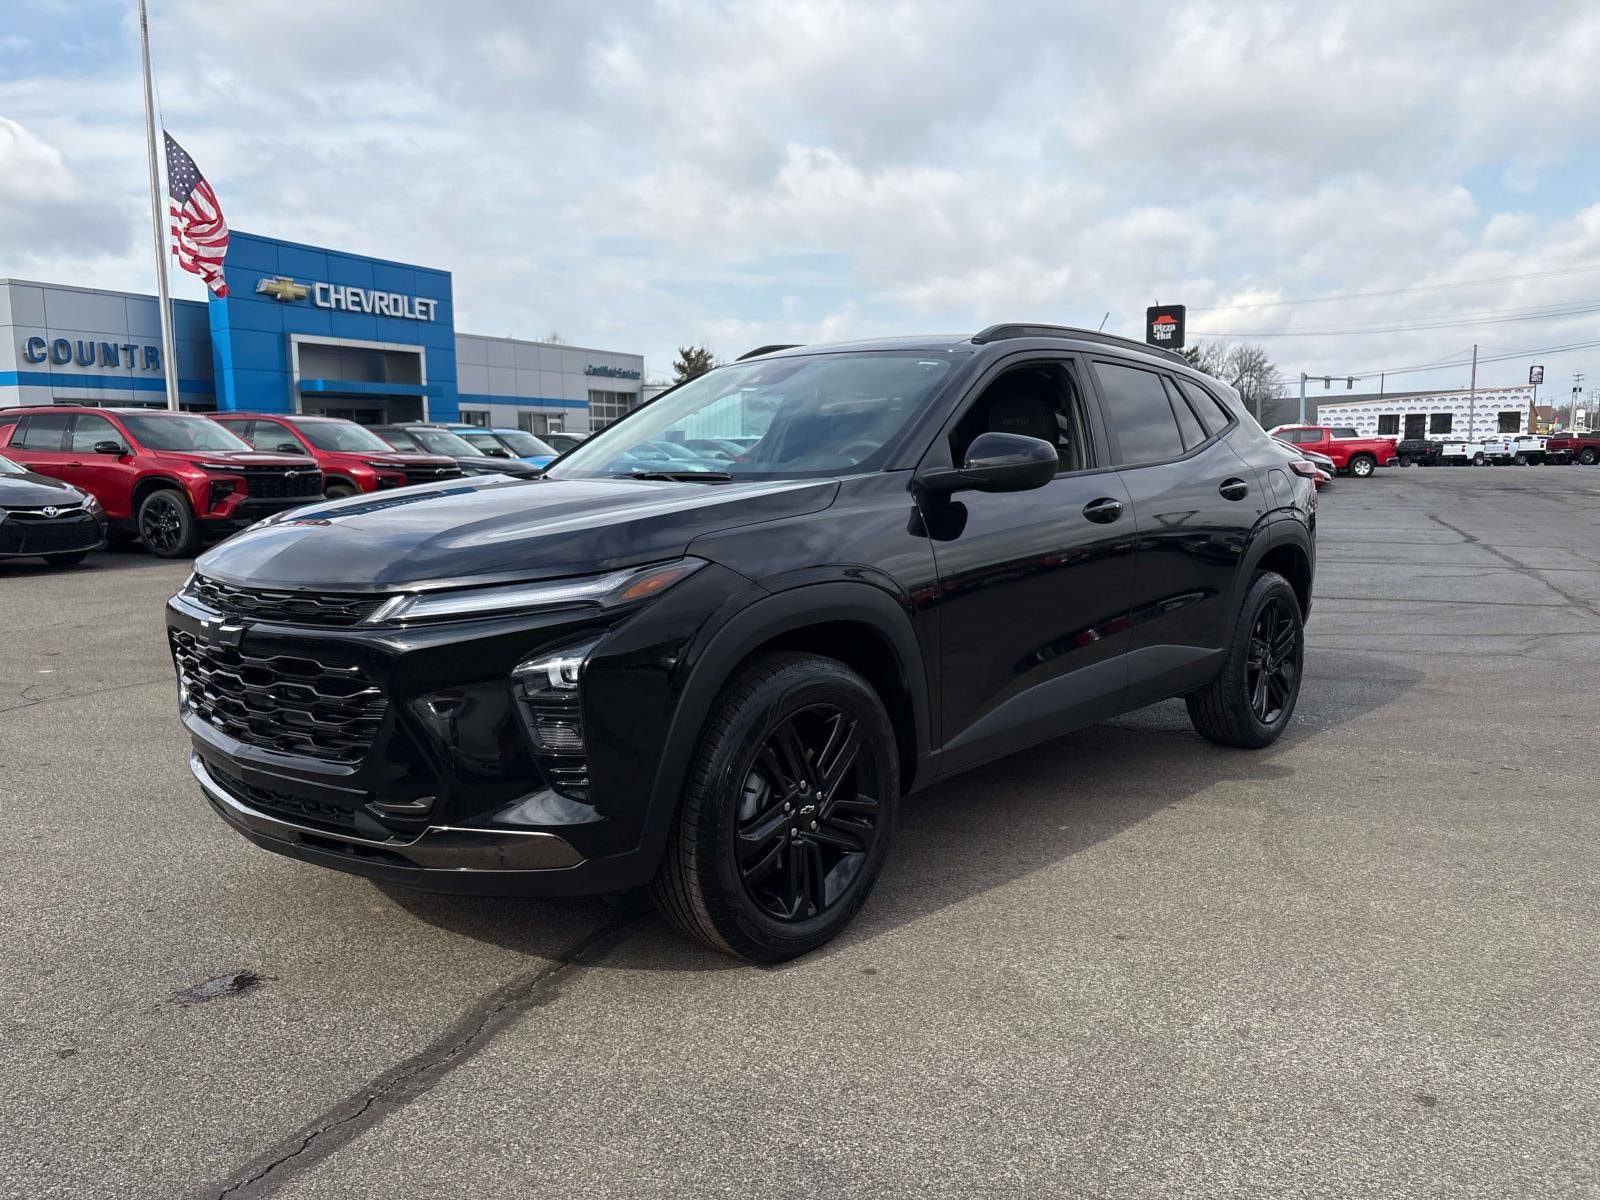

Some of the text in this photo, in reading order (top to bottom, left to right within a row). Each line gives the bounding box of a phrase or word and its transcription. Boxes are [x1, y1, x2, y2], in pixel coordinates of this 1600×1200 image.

[313, 282, 438, 321] CHEVROLET
[1153, 324, 1176, 334] Pizza
[1153, 332, 1172, 341] Hut
[24, 336, 161, 371] COUNTR
